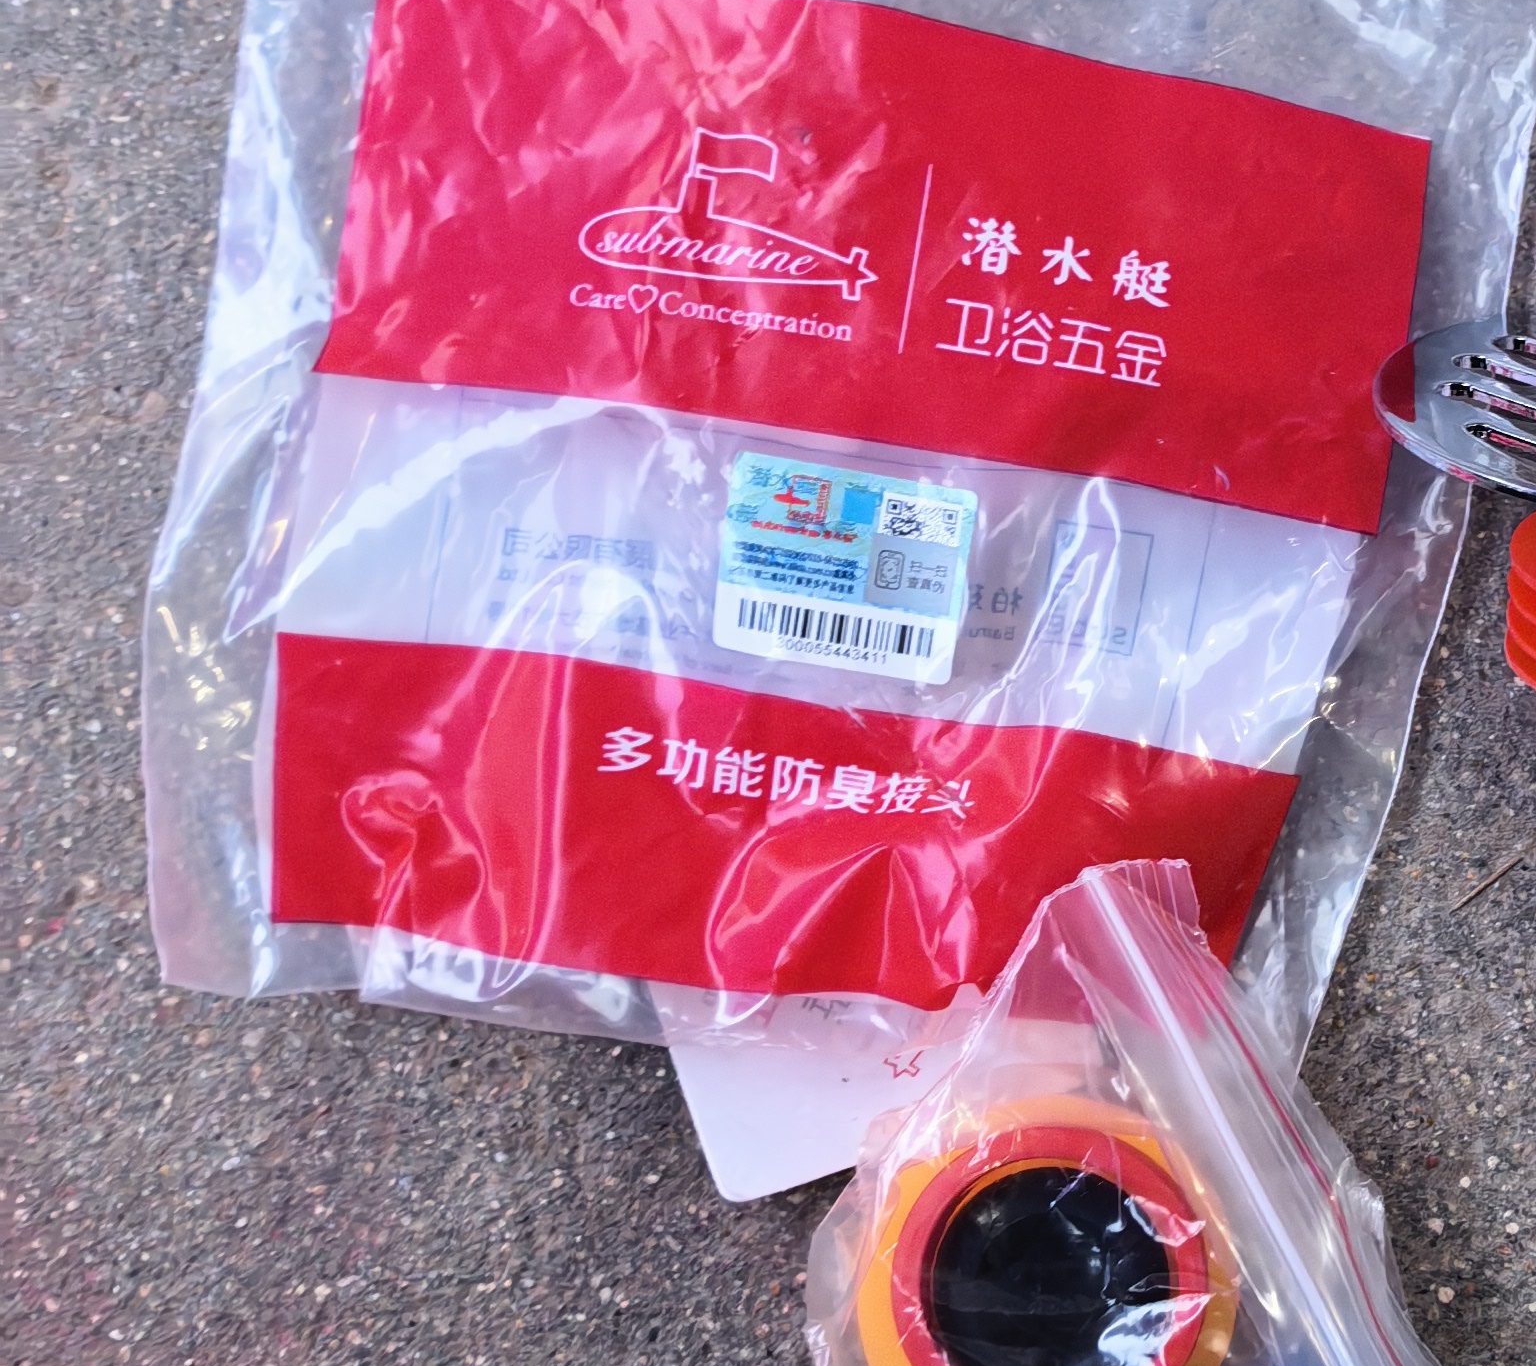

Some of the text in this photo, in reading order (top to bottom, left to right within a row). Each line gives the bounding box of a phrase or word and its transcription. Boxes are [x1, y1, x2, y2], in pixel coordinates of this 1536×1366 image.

[596, 215, 819, 276] submarine
[961, 216, 1171, 309] 潜水艇
[936, 297, 1168, 388] 卫浴五金
[776, 636, 888, 665] 300055443411
[597, 725, 977, 821] 多功能防臭接头
